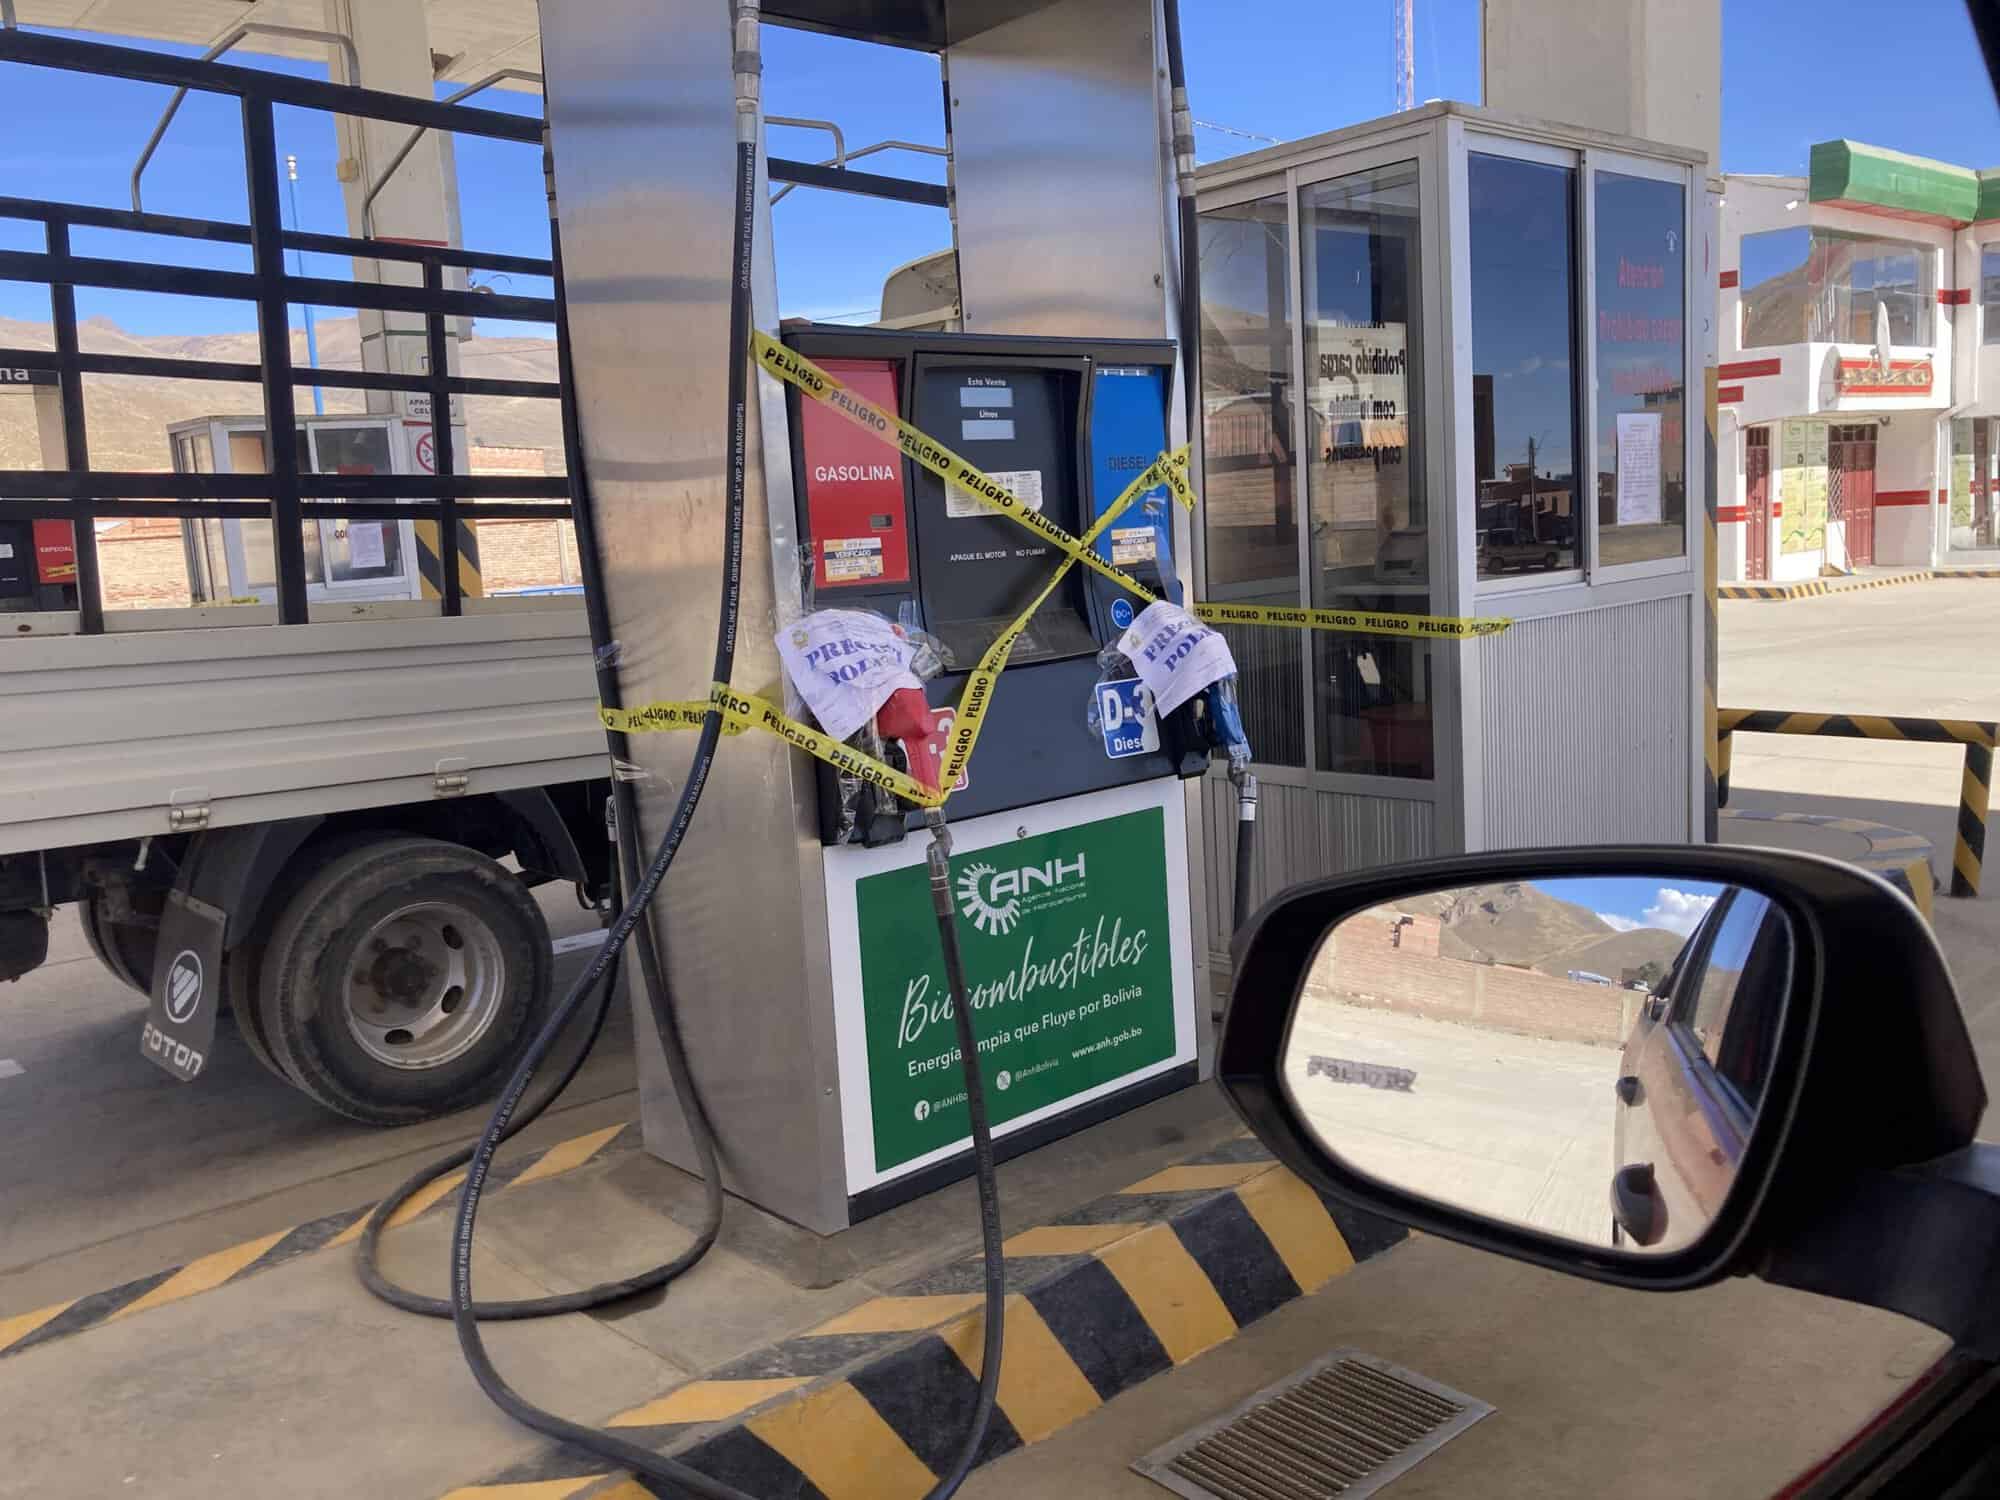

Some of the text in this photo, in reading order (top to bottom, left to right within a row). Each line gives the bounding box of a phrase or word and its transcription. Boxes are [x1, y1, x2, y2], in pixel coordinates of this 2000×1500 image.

[0, 368, 29, 381] na
[765, 347, 824, 391] PELIGRO
[831, 389, 887, 432] PELIGRO
[897, 429, 950, 470] PELIGRO
[815, 465, 894, 481] GASOLINA
[958, 469, 1013, 508] PELIGRO
[1021, 506, 1072, 544] PELIGRO
[1220, 608, 1259, 620] PELIGRO
[1266, 610, 1307, 623] PELIGRO
[1315, 613, 1356, 626] PELIGRO
[1365, 616, 1409, 630] PELIGRO
[1418, 619, 1464, 635] PELIGRO
[710, 690, 751, 715] LIGRO
[966, 677, 988, 719] PELIGRO
[762, 710, 818, 751] PELIGRO
[829, 748, 896, 789] PELIGRO
[947, 728, 972, 777] PELIGRO
[990, 852, 1086, 903] ANH
[897, 914, 1149, 1049] Bioombustibles
[143, 1022, 203, 1077] FOTON
[907, 985, 1143, 1077] Energía mpia que Fluye por Bolivia
[1071, 1026, 1143, 1059] www.anh.gob.bo
[933, 1091, 969, 1113] @ANHBo
